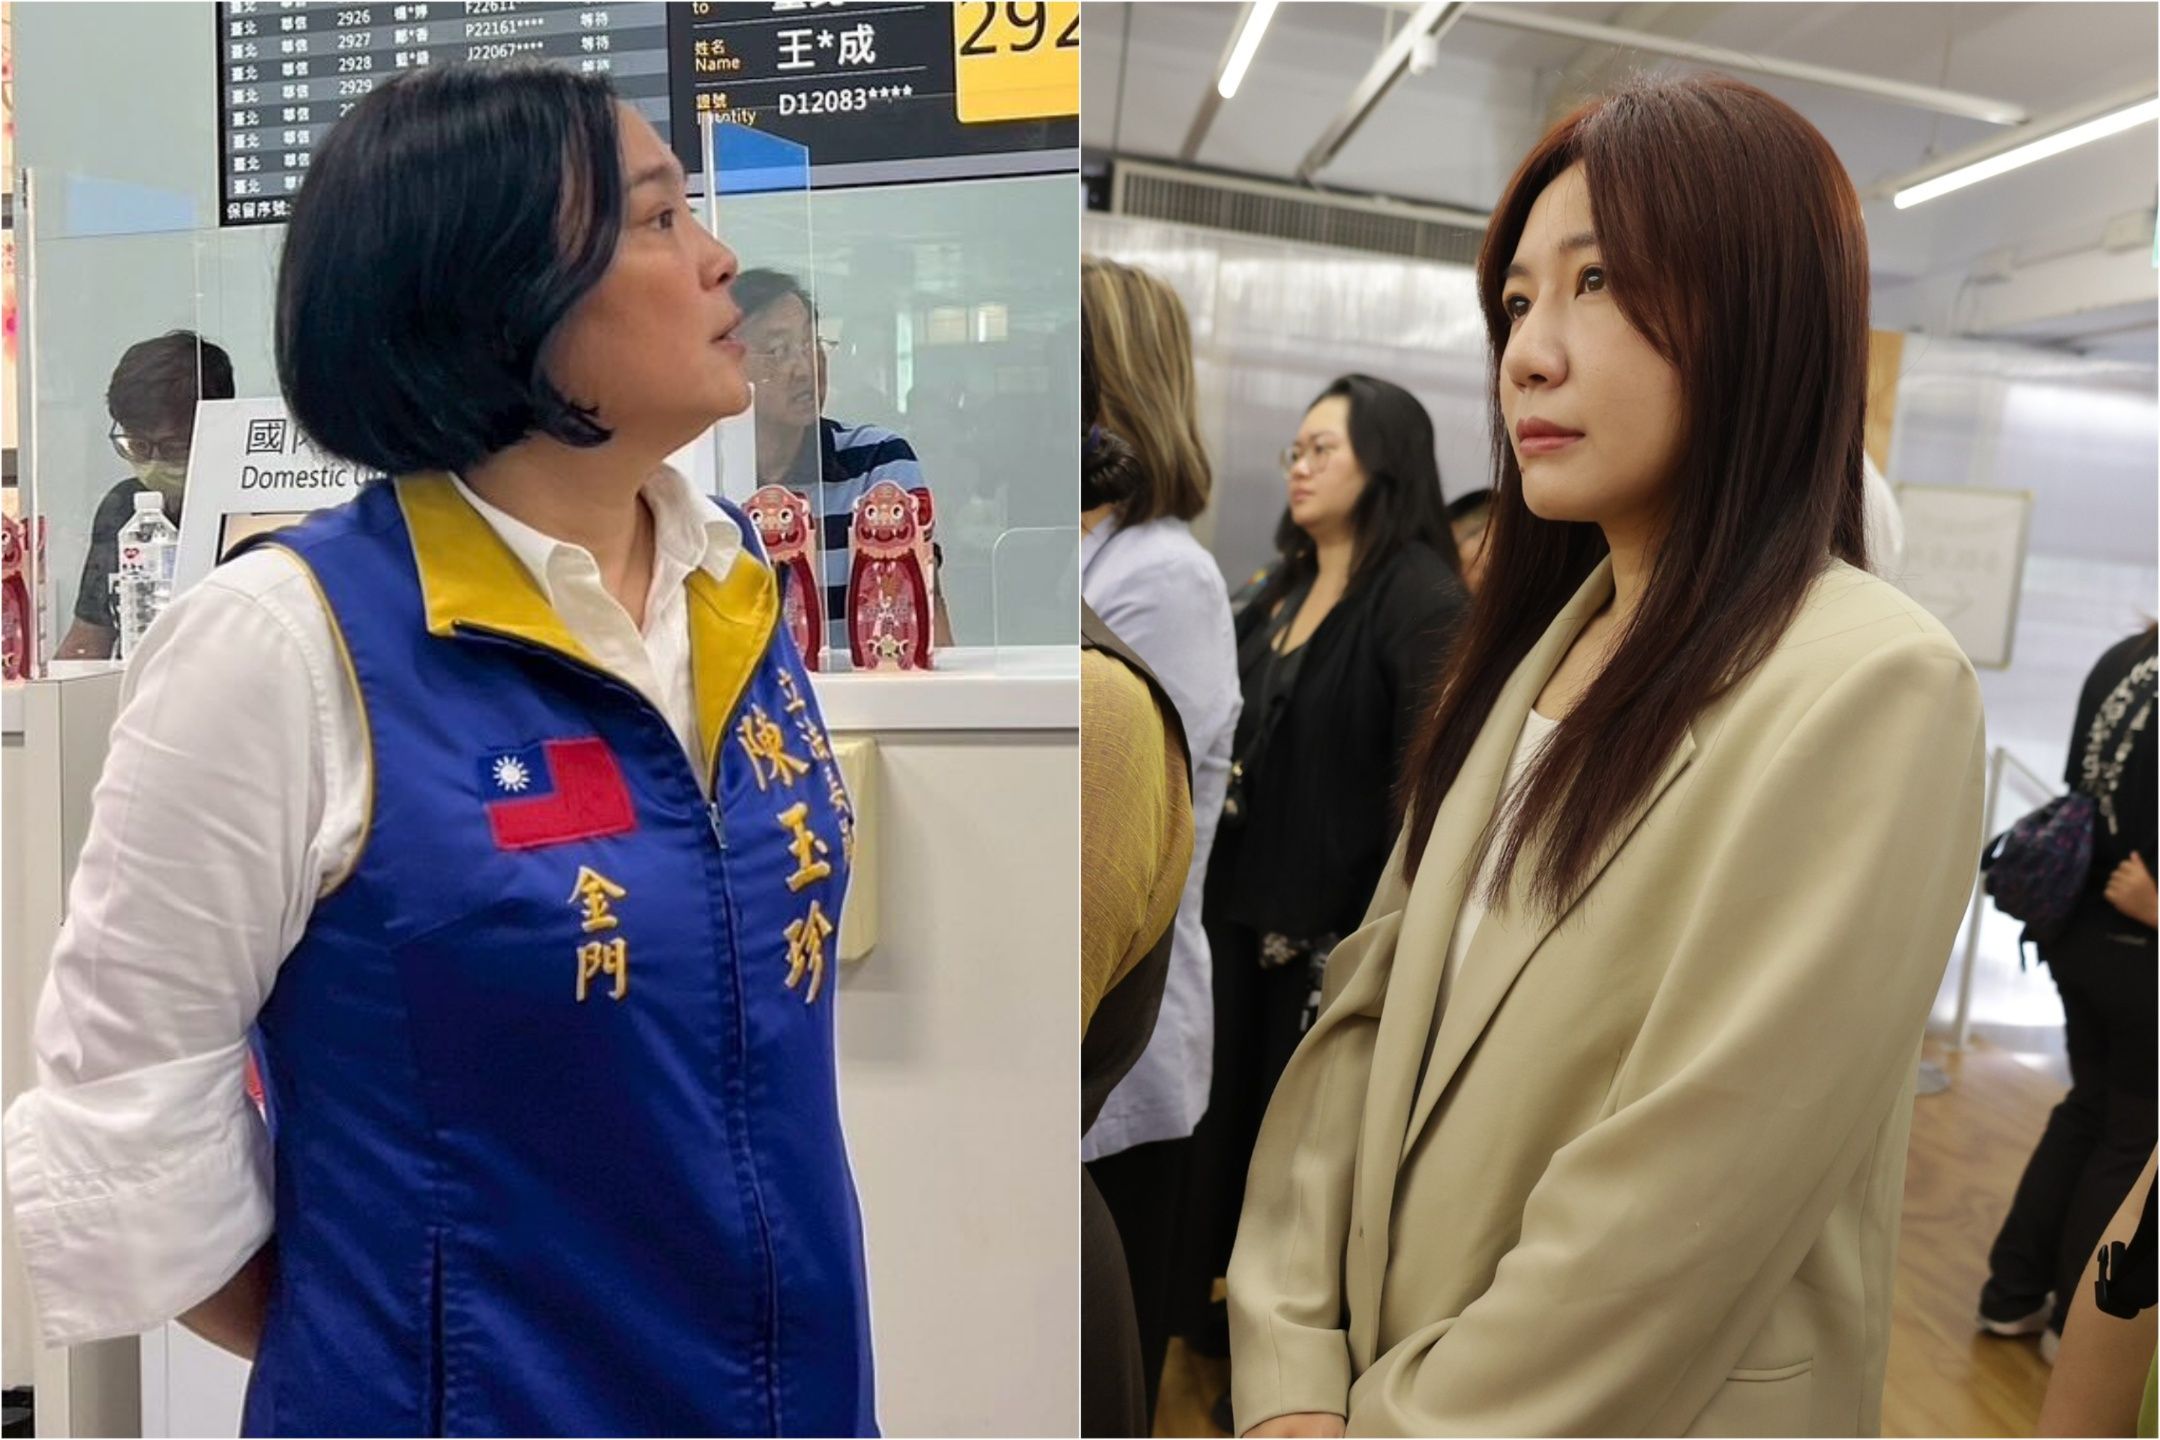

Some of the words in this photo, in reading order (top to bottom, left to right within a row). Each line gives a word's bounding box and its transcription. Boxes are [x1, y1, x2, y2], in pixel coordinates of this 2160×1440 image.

[693, 2, 710, 15] to
[337, 9, 371, 27] 2926
[337, 32, 371, 49] 2927
[695, 39, 725, 56] 姓名
[338, 55, 372, 72] 2928
[695, 57, 741, 72] Name
[339, 78, 373, 95] 2929
[697, 107, 756, 125] Ientity
[242, 465, 347, 489] Domestic
[737, 703, 833, 1003] 陳玉珍
[568, 865, 628, 1001] 金門
